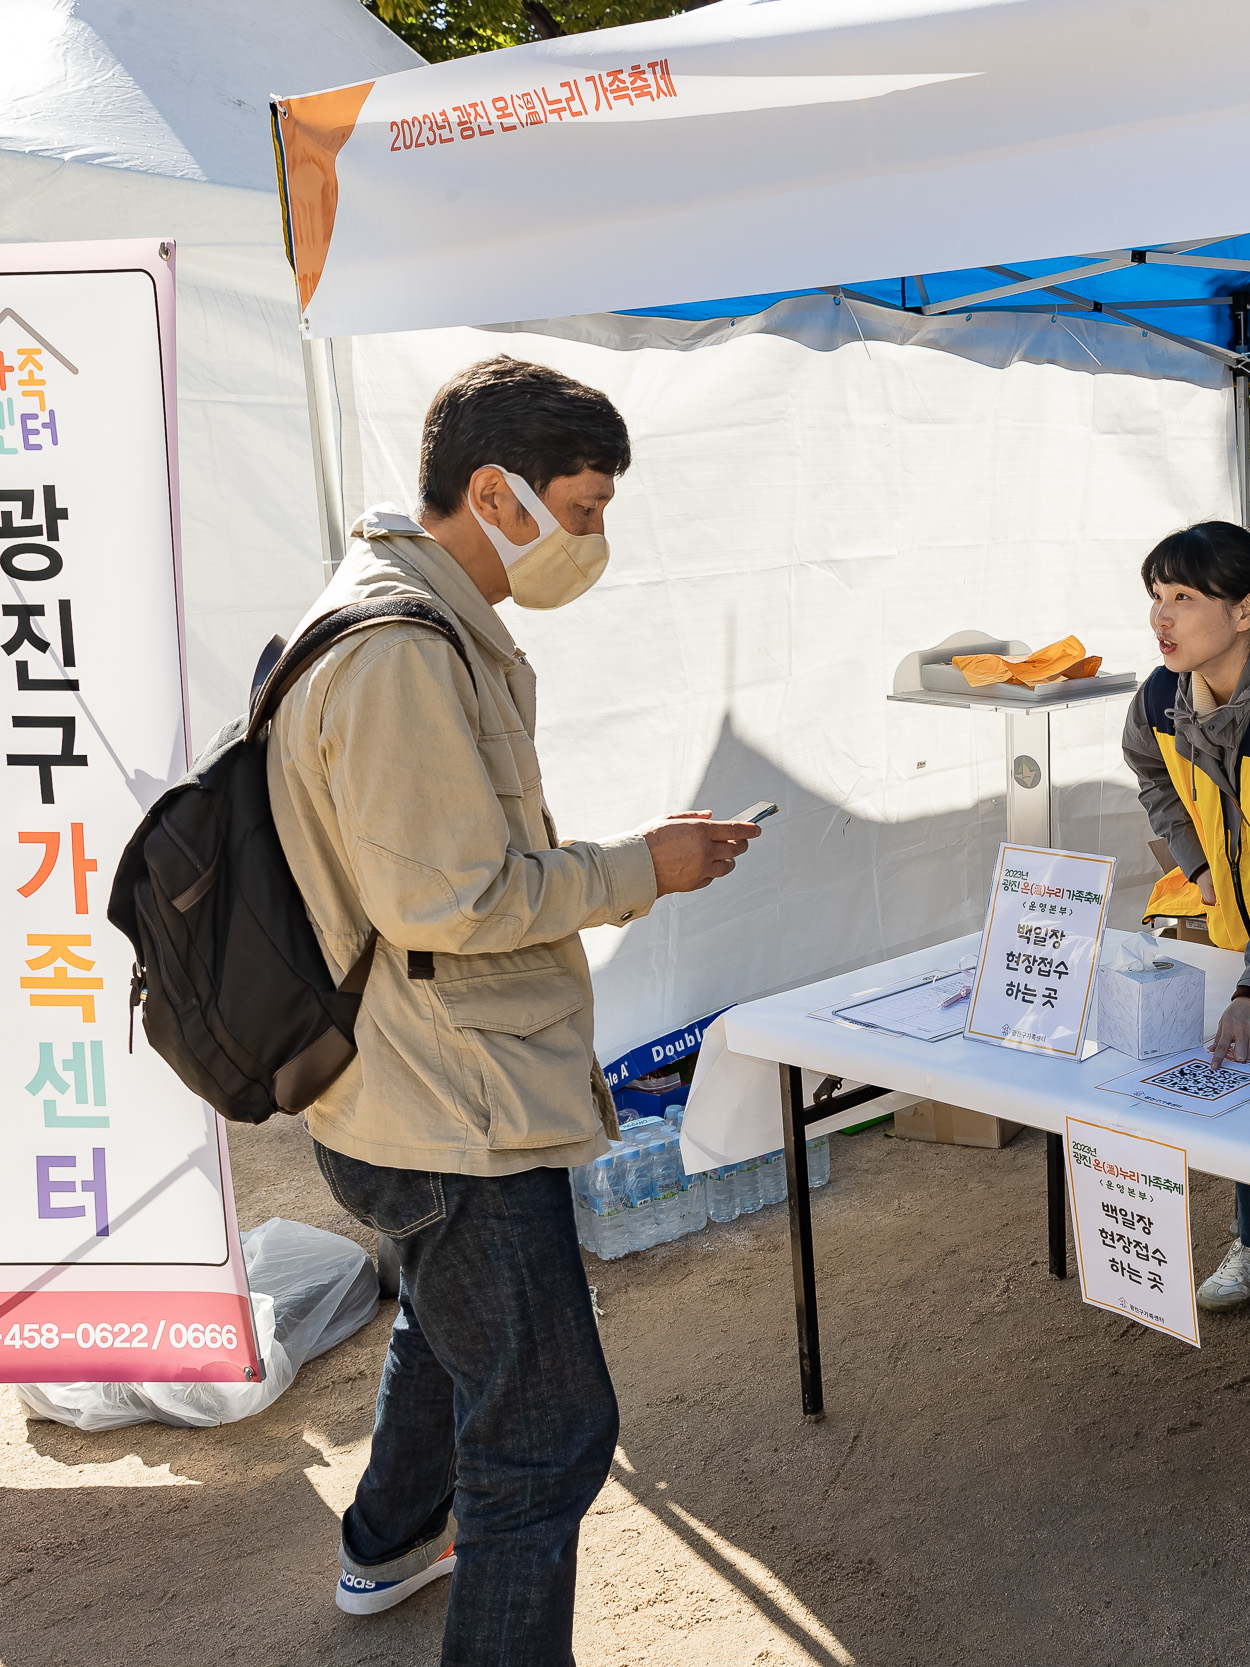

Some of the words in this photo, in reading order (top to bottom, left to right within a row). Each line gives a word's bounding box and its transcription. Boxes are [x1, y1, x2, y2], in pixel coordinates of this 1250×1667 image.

[390, 108, 455, 152] 2023년
[452, 100, 494, 140] 광진
[491, 78, 588, 133] 온(溫)누리
[584, 58, 678, 111] 가족축제
[1004, 869, 1029, 880] 2023년
[1002, 879, 1021, 892] 광진
[1066, 889, 1104, 905] 가족축제
[1017, 924, 1066, 949] 백일장
[1006, 951, 1069, 980] 현장접수
[1006, 981, 1037, 1004] 하는
[1042, 987, 1058, 1008] 곳
[651, 1028, 705, 1062] Doubl
[1012, 1030, 1047, 1043] 광진구가족센터
[1072, 1141, 1097, 1157] 2023년
[1072, 1151, 1092, 1168] 광진
[1141, 1174, 1184, 1196] 가족축제
[1102, 1202, 1154, 1235] 백일장
[1098, 1228, 1168, 1266] 현장접수
[1108, 1257, 1142, 1285] 하는
[1147, 1271, 1164, 1293] 곳
[0, 1320, 238, 1350] 458-0622/0666
